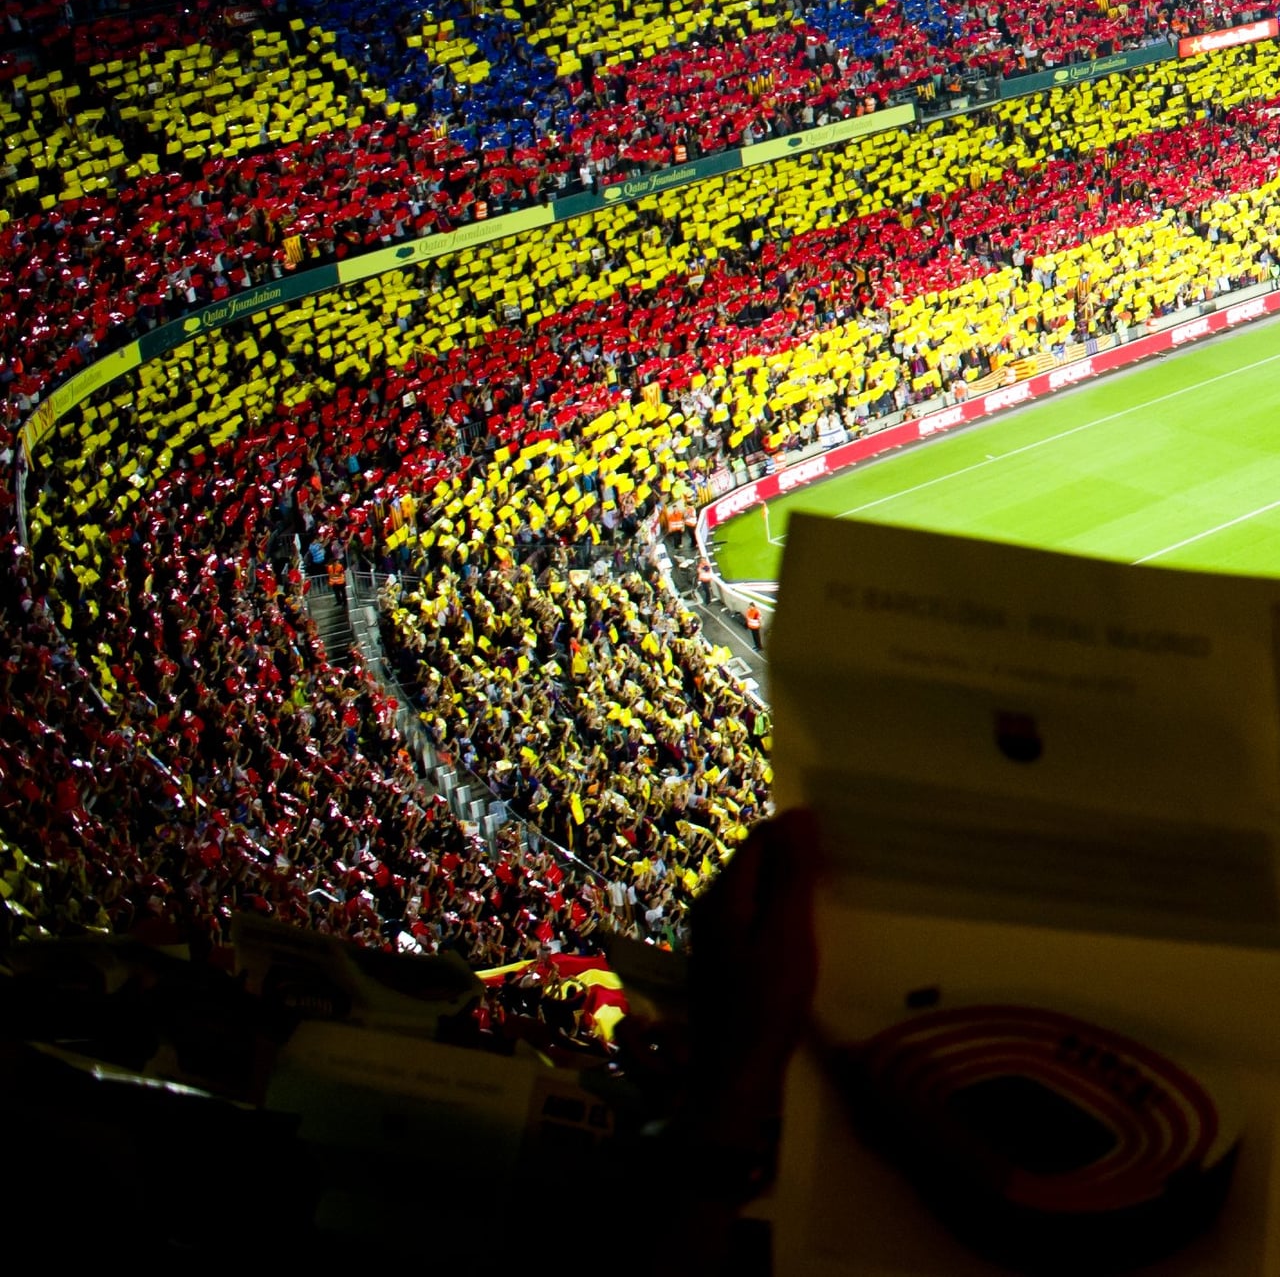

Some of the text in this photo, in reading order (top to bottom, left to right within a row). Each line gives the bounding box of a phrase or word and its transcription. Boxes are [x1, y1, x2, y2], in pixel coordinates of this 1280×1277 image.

[624, 166, 696, 197] Qatar Foundation
[418, 221, 503, 255] Qatar Foundation
[202, 285, 282, 328] Qatar Foundation
